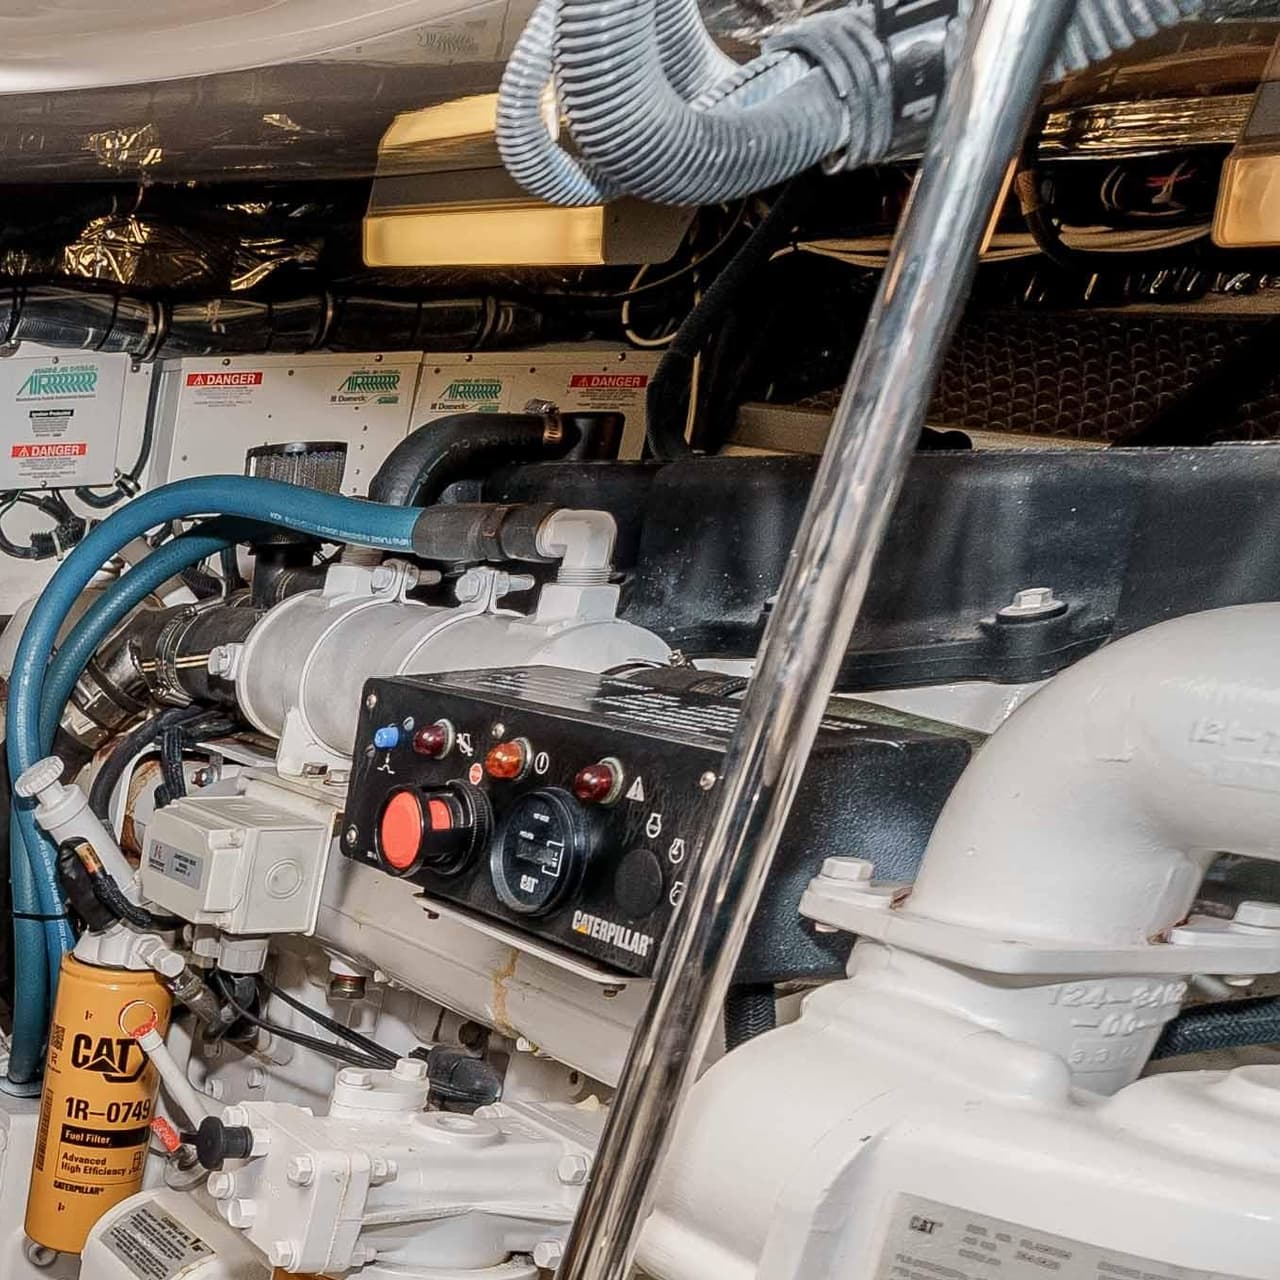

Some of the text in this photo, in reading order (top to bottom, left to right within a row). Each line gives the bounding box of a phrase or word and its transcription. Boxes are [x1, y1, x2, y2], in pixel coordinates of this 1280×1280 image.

[207, 373, 255, 385] DANGER
[591, 377, 641, 387] DANGER
[32, 445, 80, 457] DANGER
[572, 910, 649, 957] CATERPILLAR
[71, 1033, 141, 1075] CAT
[65, 1096, 151, 1123] 1R-0749
[65, 1130, 111, 1144] Fuel Filter
[62, 1151, 107, 1166] Advanced
[61, 1163, 127, 1176] High Efficiency
[53, 1180, 102, 1196] CATERPILLAR
